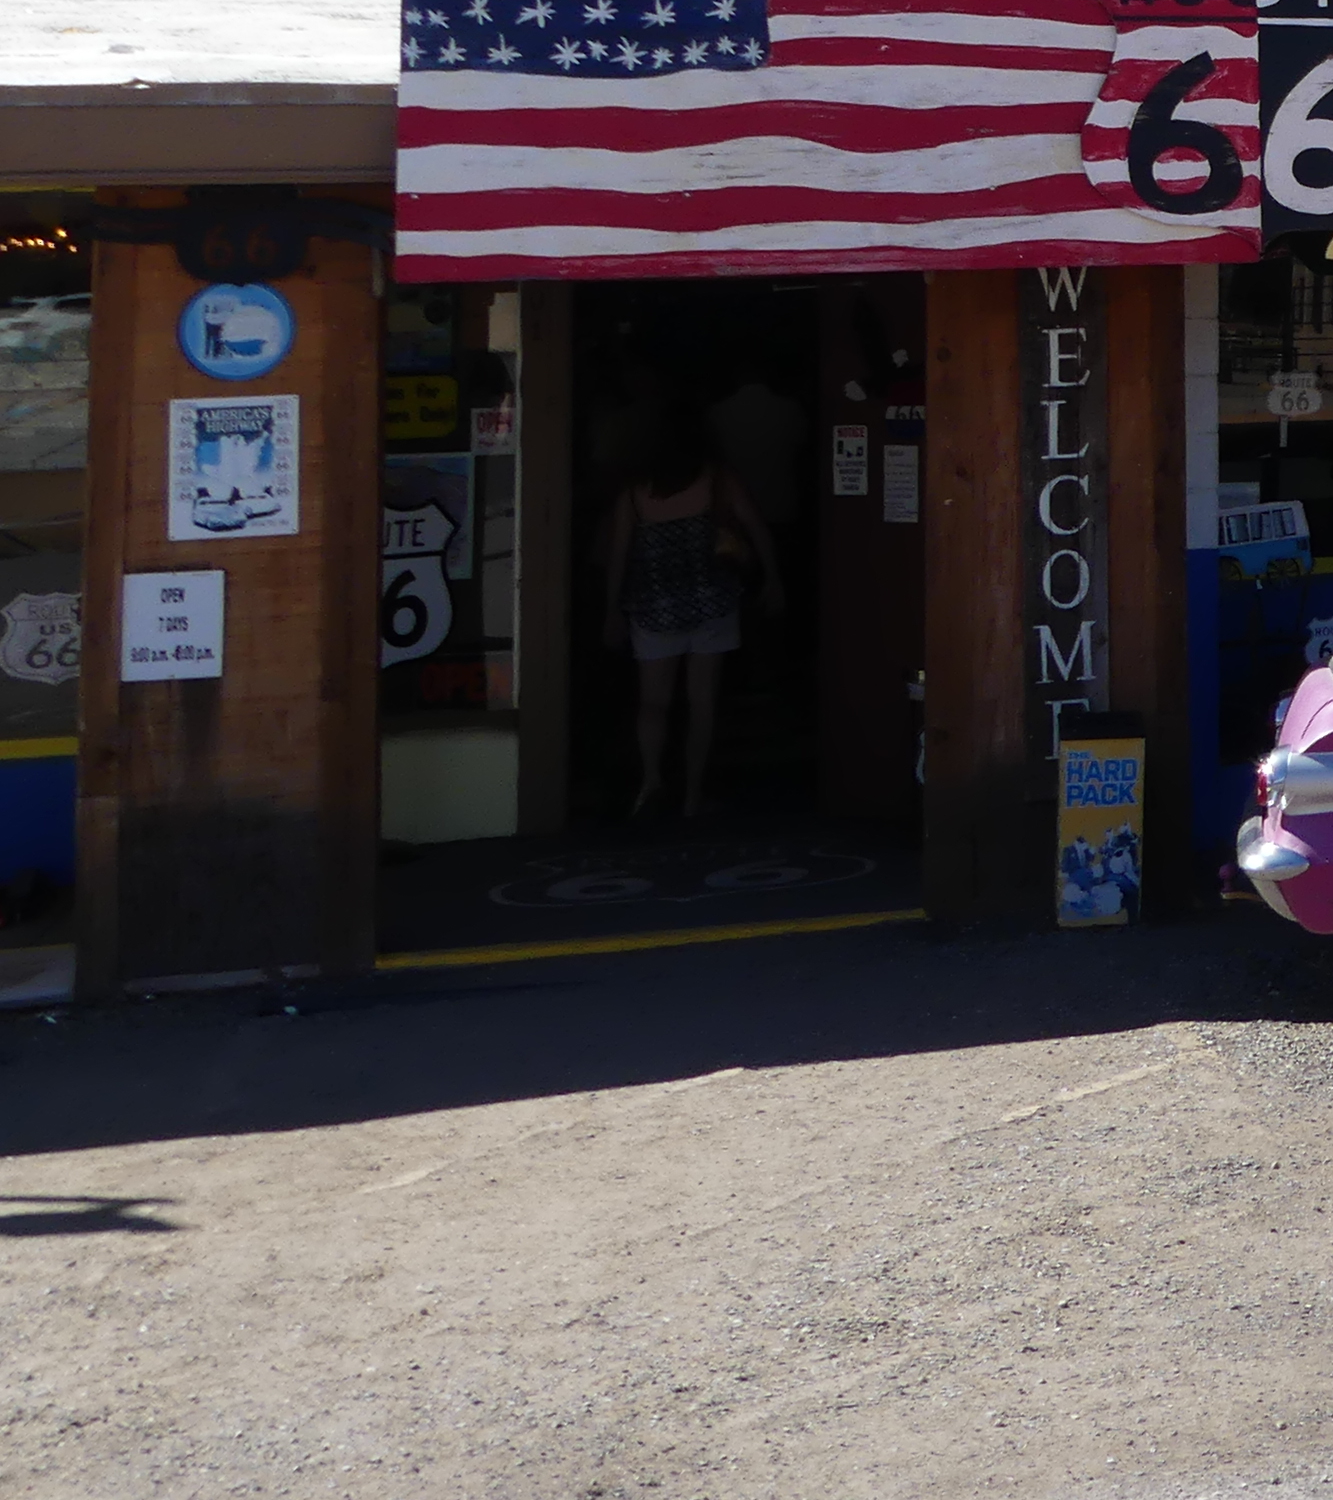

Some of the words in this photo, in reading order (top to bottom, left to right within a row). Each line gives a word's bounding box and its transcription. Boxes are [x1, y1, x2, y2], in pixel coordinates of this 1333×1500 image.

[204, 222, 280, 268] 66
[1281, 391, 1310, 413] 66
[204, 419, 263, 434] HIGHWAY
[160, 587, 185, 603] OPEN
[40, 622, 72, 636] US
[158, 616, 165, 632] 7
[166, 616, 189, 632] DAYS
[26, 638, 80, 669] 66
[1065, 759, 1137, 782] HARD
[1065, 782, 1136, 807] PACK
